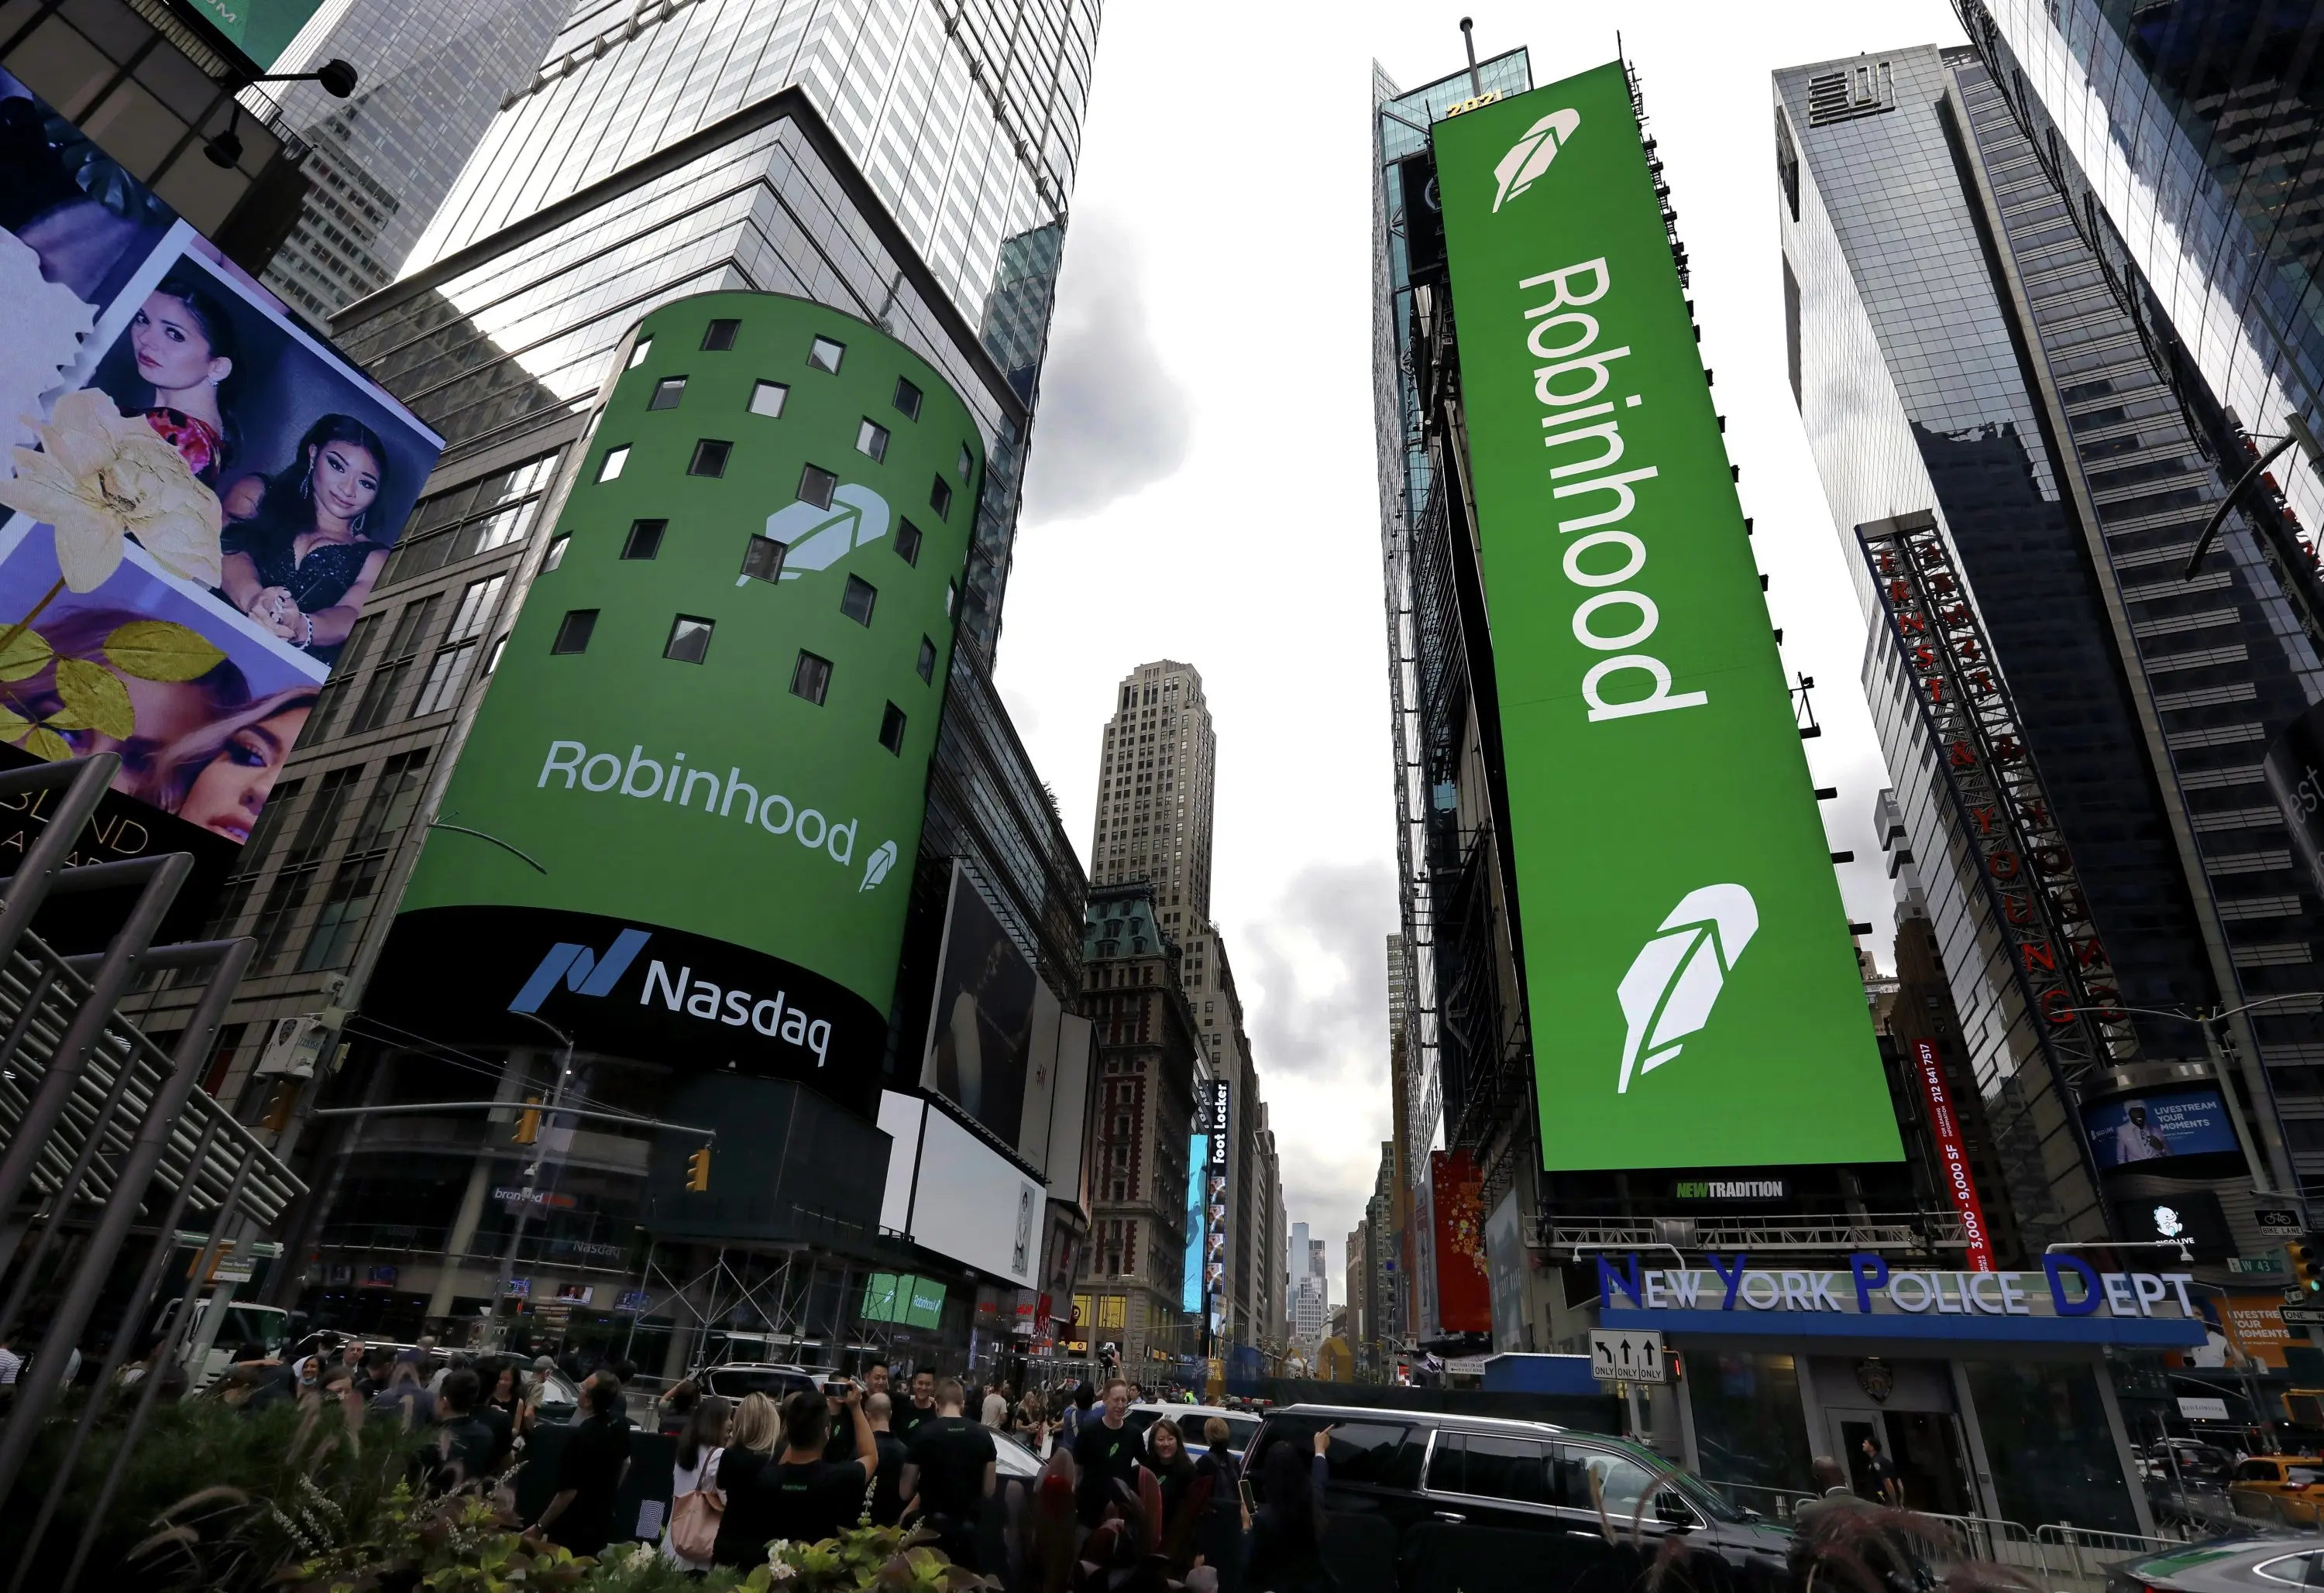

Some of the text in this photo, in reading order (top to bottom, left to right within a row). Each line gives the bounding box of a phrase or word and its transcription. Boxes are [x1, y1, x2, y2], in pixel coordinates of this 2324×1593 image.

[1446, 89, 1502, 117] 2021
[1519, 257, 1708, 722] Robinhood
[537, 740, 858, 867] Robinhood
[640, 960, 832, 1068] Nasdaq
[1920, 1043, 1944, 1103] 212 841 7517
[2154, 1100, 2217, 1115] LIVESTREAM
[1213, 1083, 1227, 1163] Foot Locker
[1941, 1105, 1953, 1137] INFORMATION
[2157, 1113, 2184, 1123] YOUR
[2160, 1119, 2210, 1131] MOMENTS
[1945, 1144, 1959, 1159] SF
[1952, 1162, 1970, 1200] 9,000
[494, 1187, 544, 1203] braned
[1963, 1212, 1983, 1250] 3,000
[2283, 1227, 2302, 1235] LANE
[572, 1241, 621, 1259] Nasdaq
[2257, 1260, 2271, 1272] 43
[1596, 1252, 2194, 1317] NEW YORK POLICE DEPT
[1595, 1366, 1614, 1375] ONLY
[1618, 1368, 1637, 1377] ONLY
[1641, 1369, 1661, 1378] ONLY
